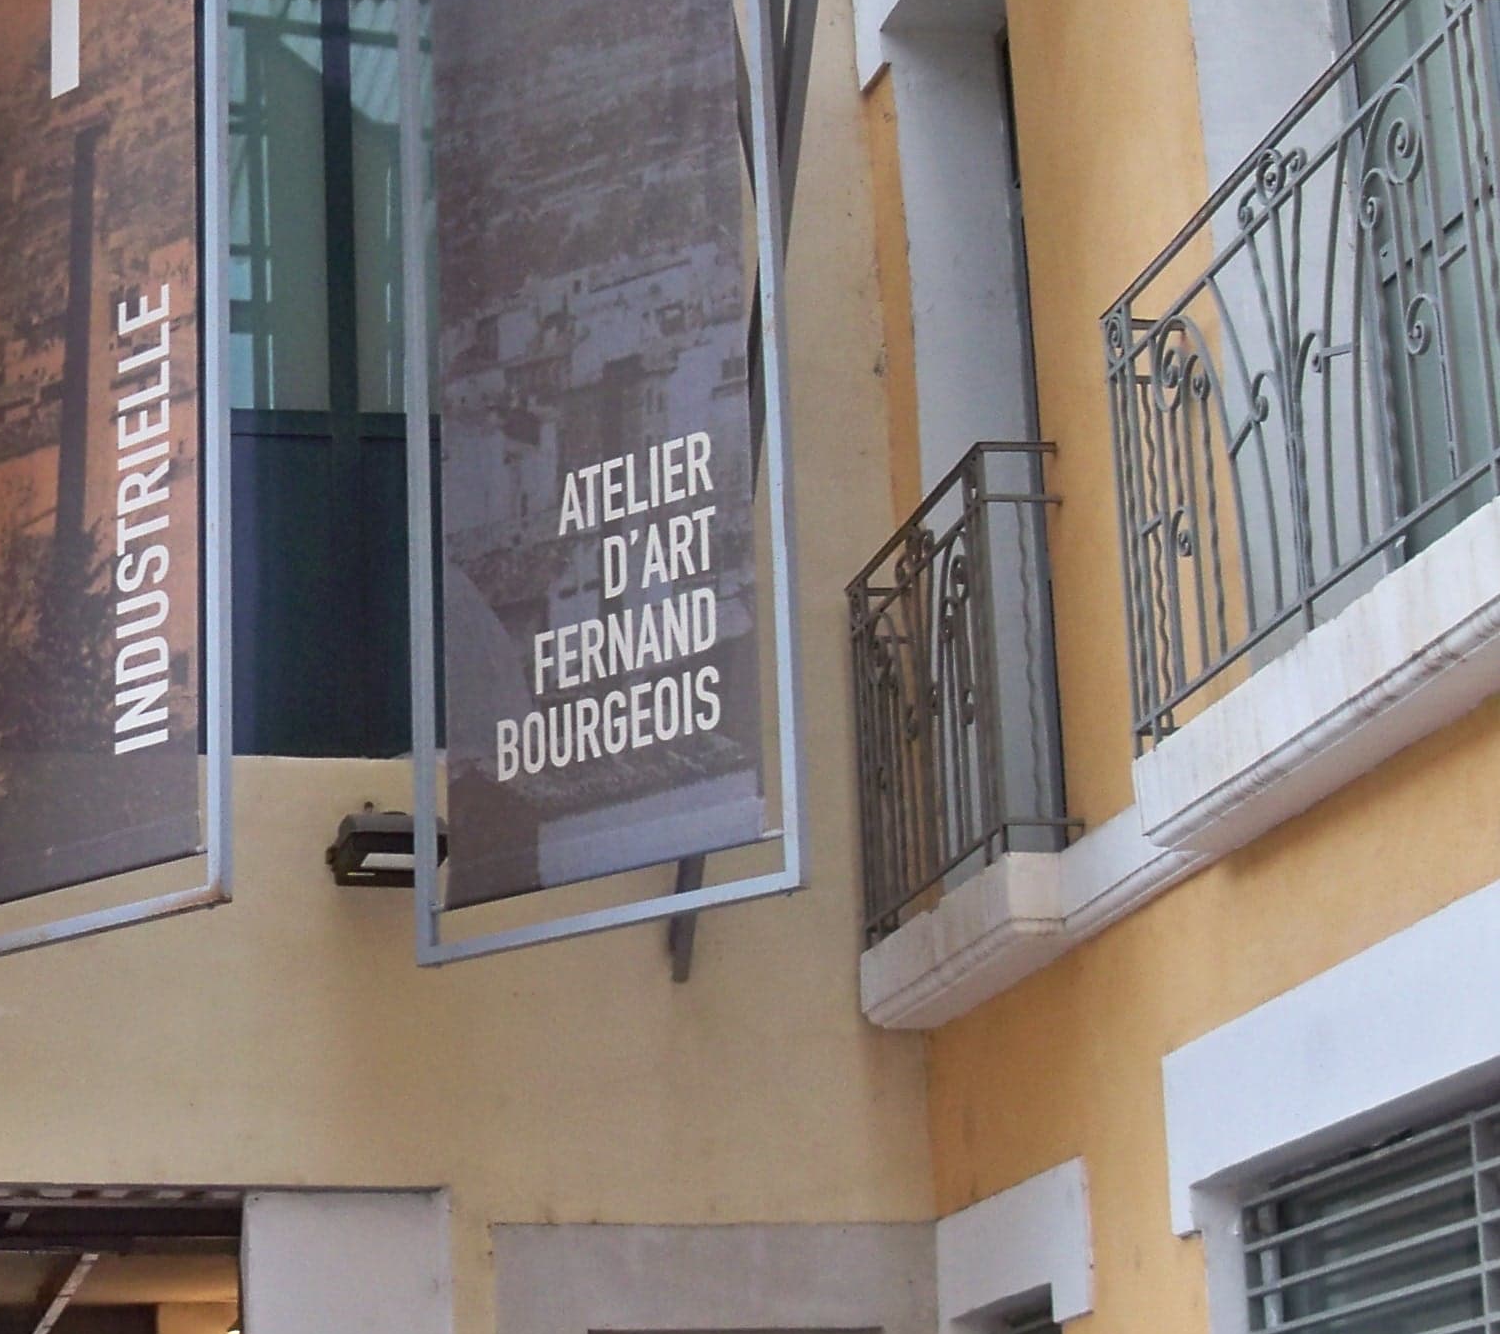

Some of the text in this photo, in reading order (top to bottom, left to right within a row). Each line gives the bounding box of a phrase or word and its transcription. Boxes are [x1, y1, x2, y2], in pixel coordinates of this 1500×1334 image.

[114, 283, 171, 756] INDUSTRIELLE
[558, 430, 715, 537] ATELIER
[603, 506, 715, 602] D'ART
[533, 585, 718, 695] FERNAND
[497, 666, 722, 784] BOURGEOIS
